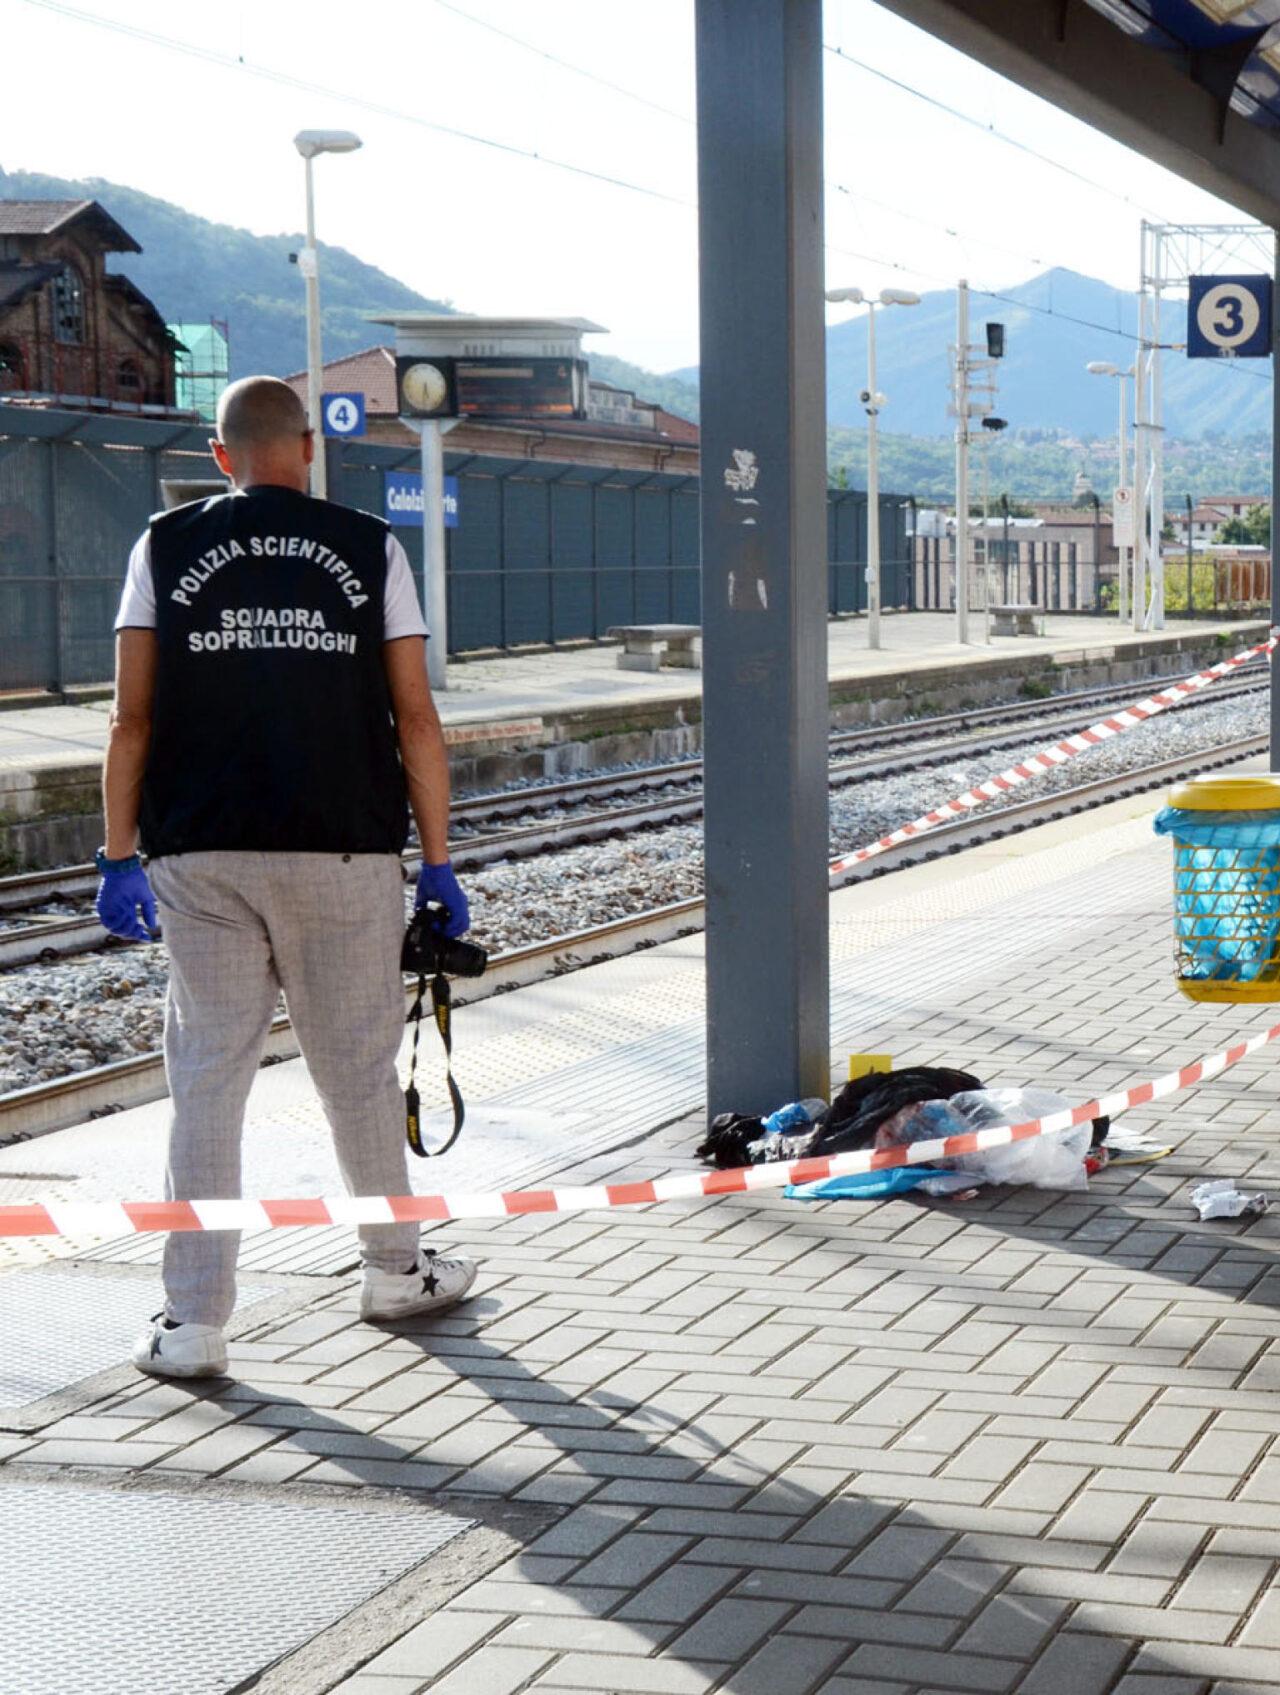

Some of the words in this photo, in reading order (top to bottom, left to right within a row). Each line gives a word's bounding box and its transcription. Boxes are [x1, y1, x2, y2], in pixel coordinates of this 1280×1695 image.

[1213, 295, 1244, 337] 3
[334, 405, 350, 426] 4
[171, 539, 246, 606] POLIZIA
[250, 536, 369, 609] SCIENTIFICA
[220, 608, 326, 629] SQUADRA
[188, 629, 357, 654] SOPRALLUOGHI
